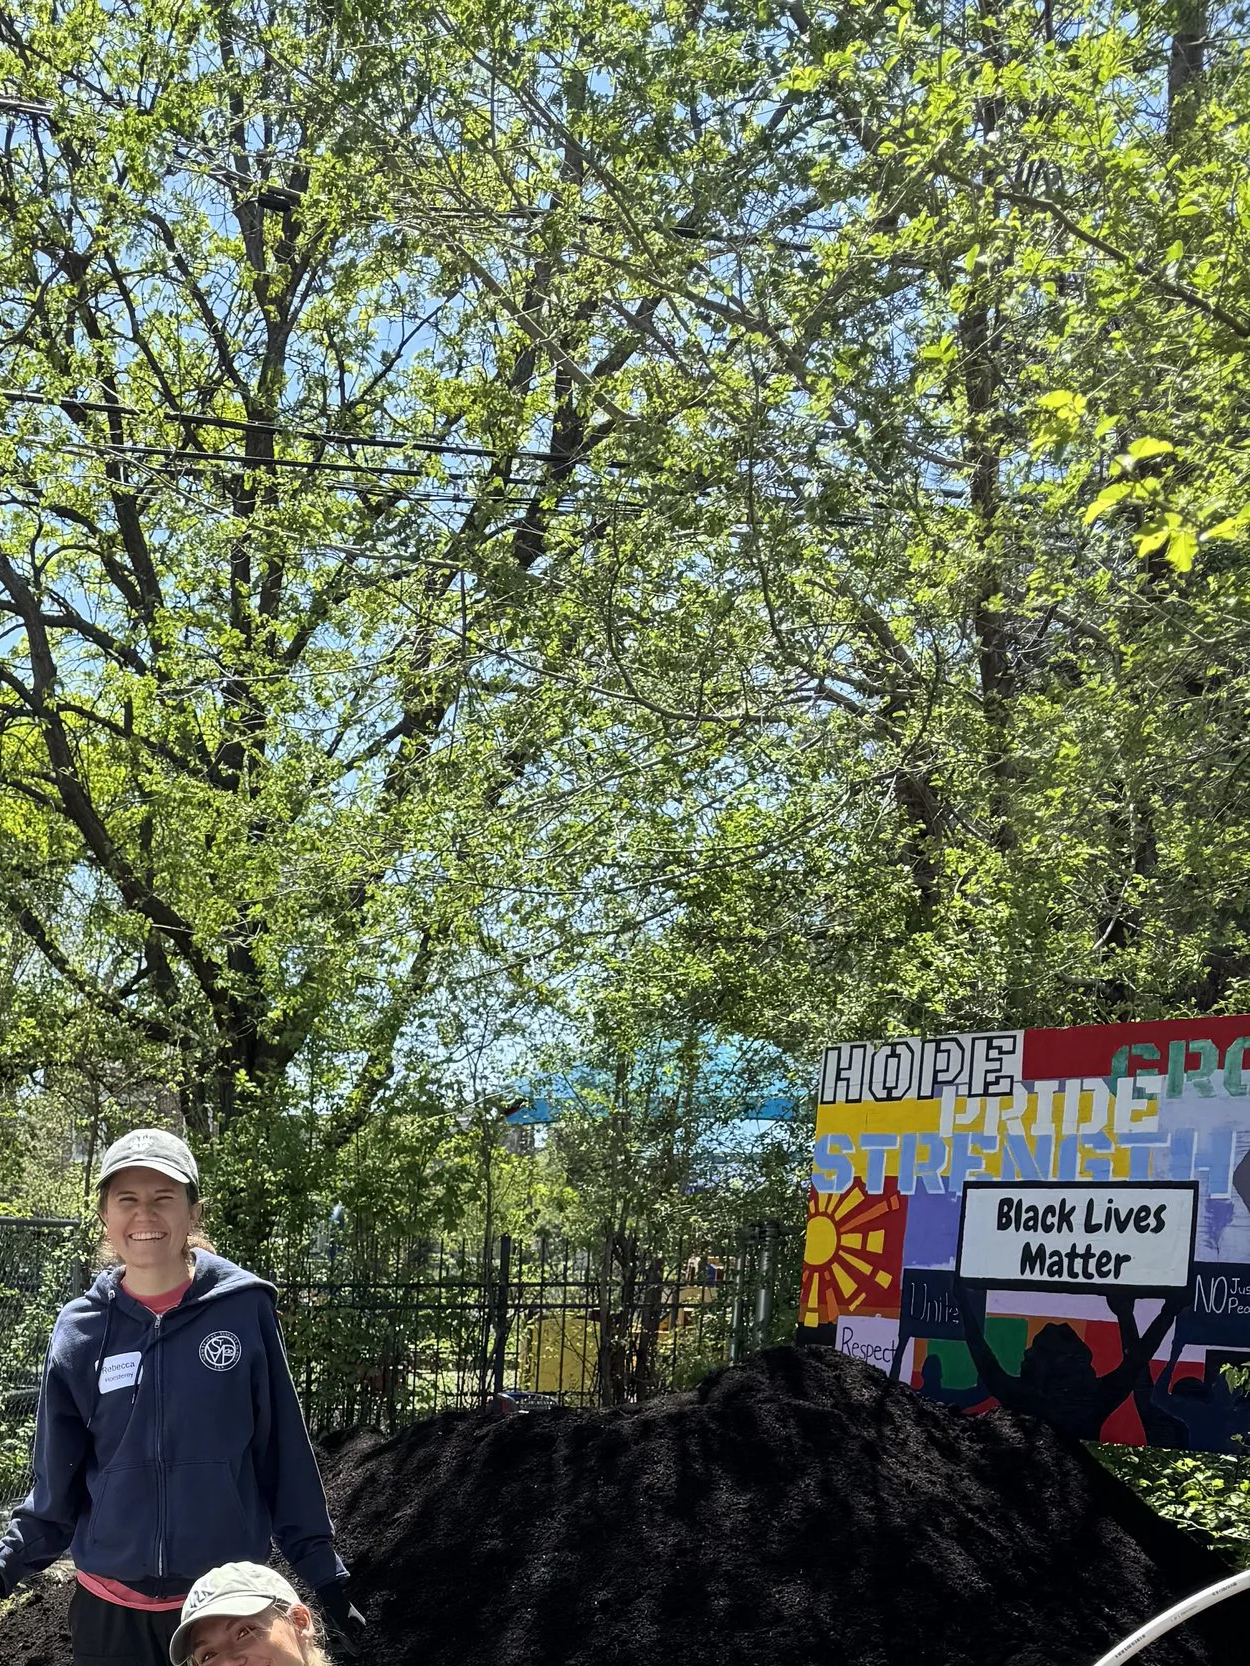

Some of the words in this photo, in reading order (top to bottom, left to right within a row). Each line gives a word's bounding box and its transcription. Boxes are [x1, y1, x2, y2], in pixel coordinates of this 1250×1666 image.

[820, 1034, 1017, 1105] HOPE
[939, 1076, 1163, 1138] PRIDE
[811, 1128, 1238, 1199] STRENGTH
[996, 1197, 1076, 1233] Black
[1084, 1198, 1166, 1234] Lives
[1019, 1241, 1132, 1280] Matter
[1193, 1274, 1228, 1314] NO
[842, 1326, 898, 1364] Respect
[102, 1360, 136, 1375] Rebecca
